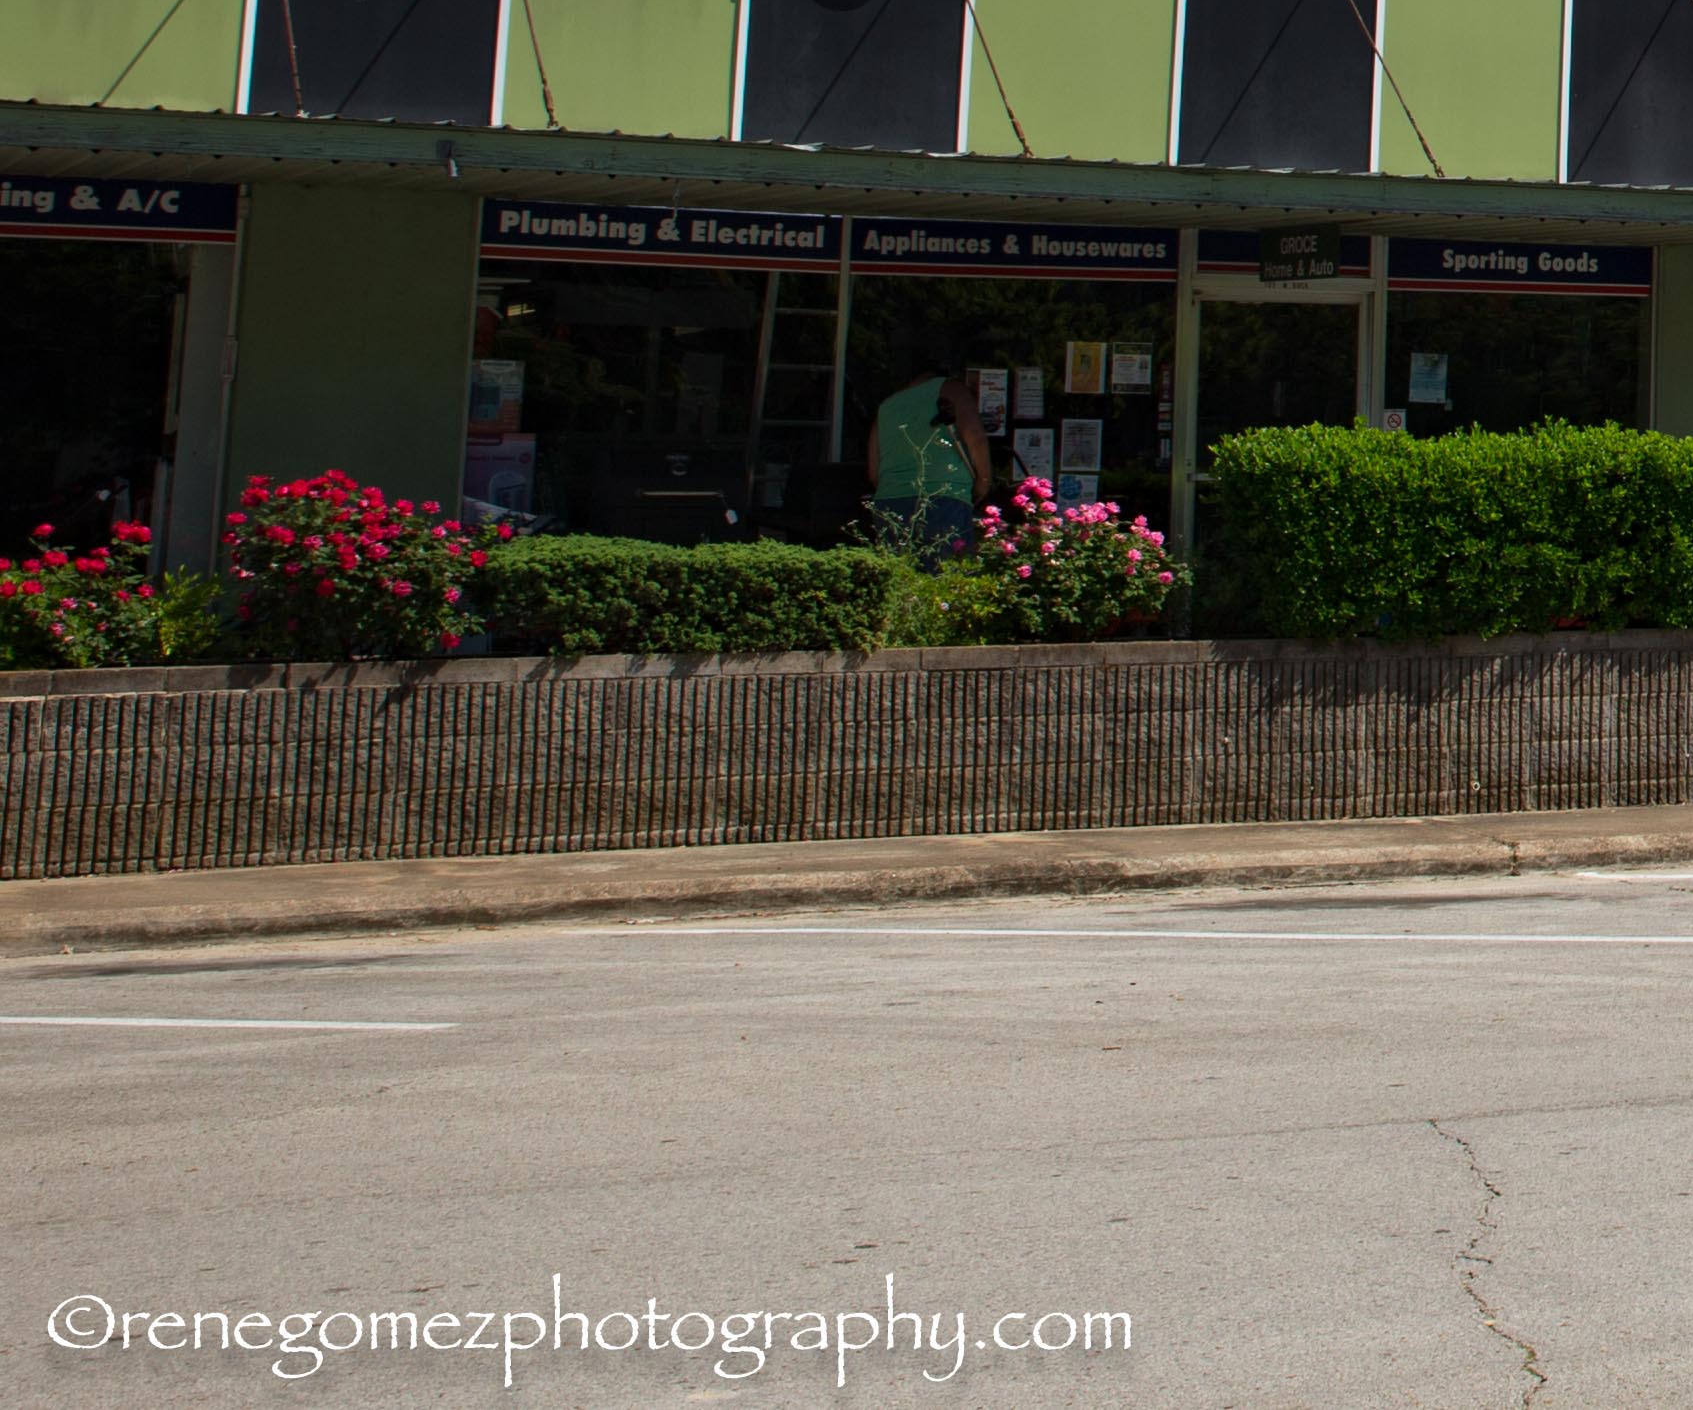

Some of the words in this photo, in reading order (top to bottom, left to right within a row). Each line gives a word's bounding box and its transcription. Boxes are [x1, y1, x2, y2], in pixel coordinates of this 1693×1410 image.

[69, 184, 102, 211] &
[116, 187, 181, 215] A/C
[498, 209, 648, 246] Plumbing
[656, 217, 682, 242] &
[690, 219, 826, 249] Electrical
[863, 228, 993, 256] Appliances
[1002, 233, 1021, 256] &
[1031, 234, 1168, 260] Housewares
[1279, 234, 1319, 256] GROCE
[1264, 261, 1294, 280] Home
[1295, 259, 1305, 277] &
[1308, 257, 1335, 277] Auto
[1441, 247, 1529, 275] Sporting
[1537, 251, 1600, 274] Goods
